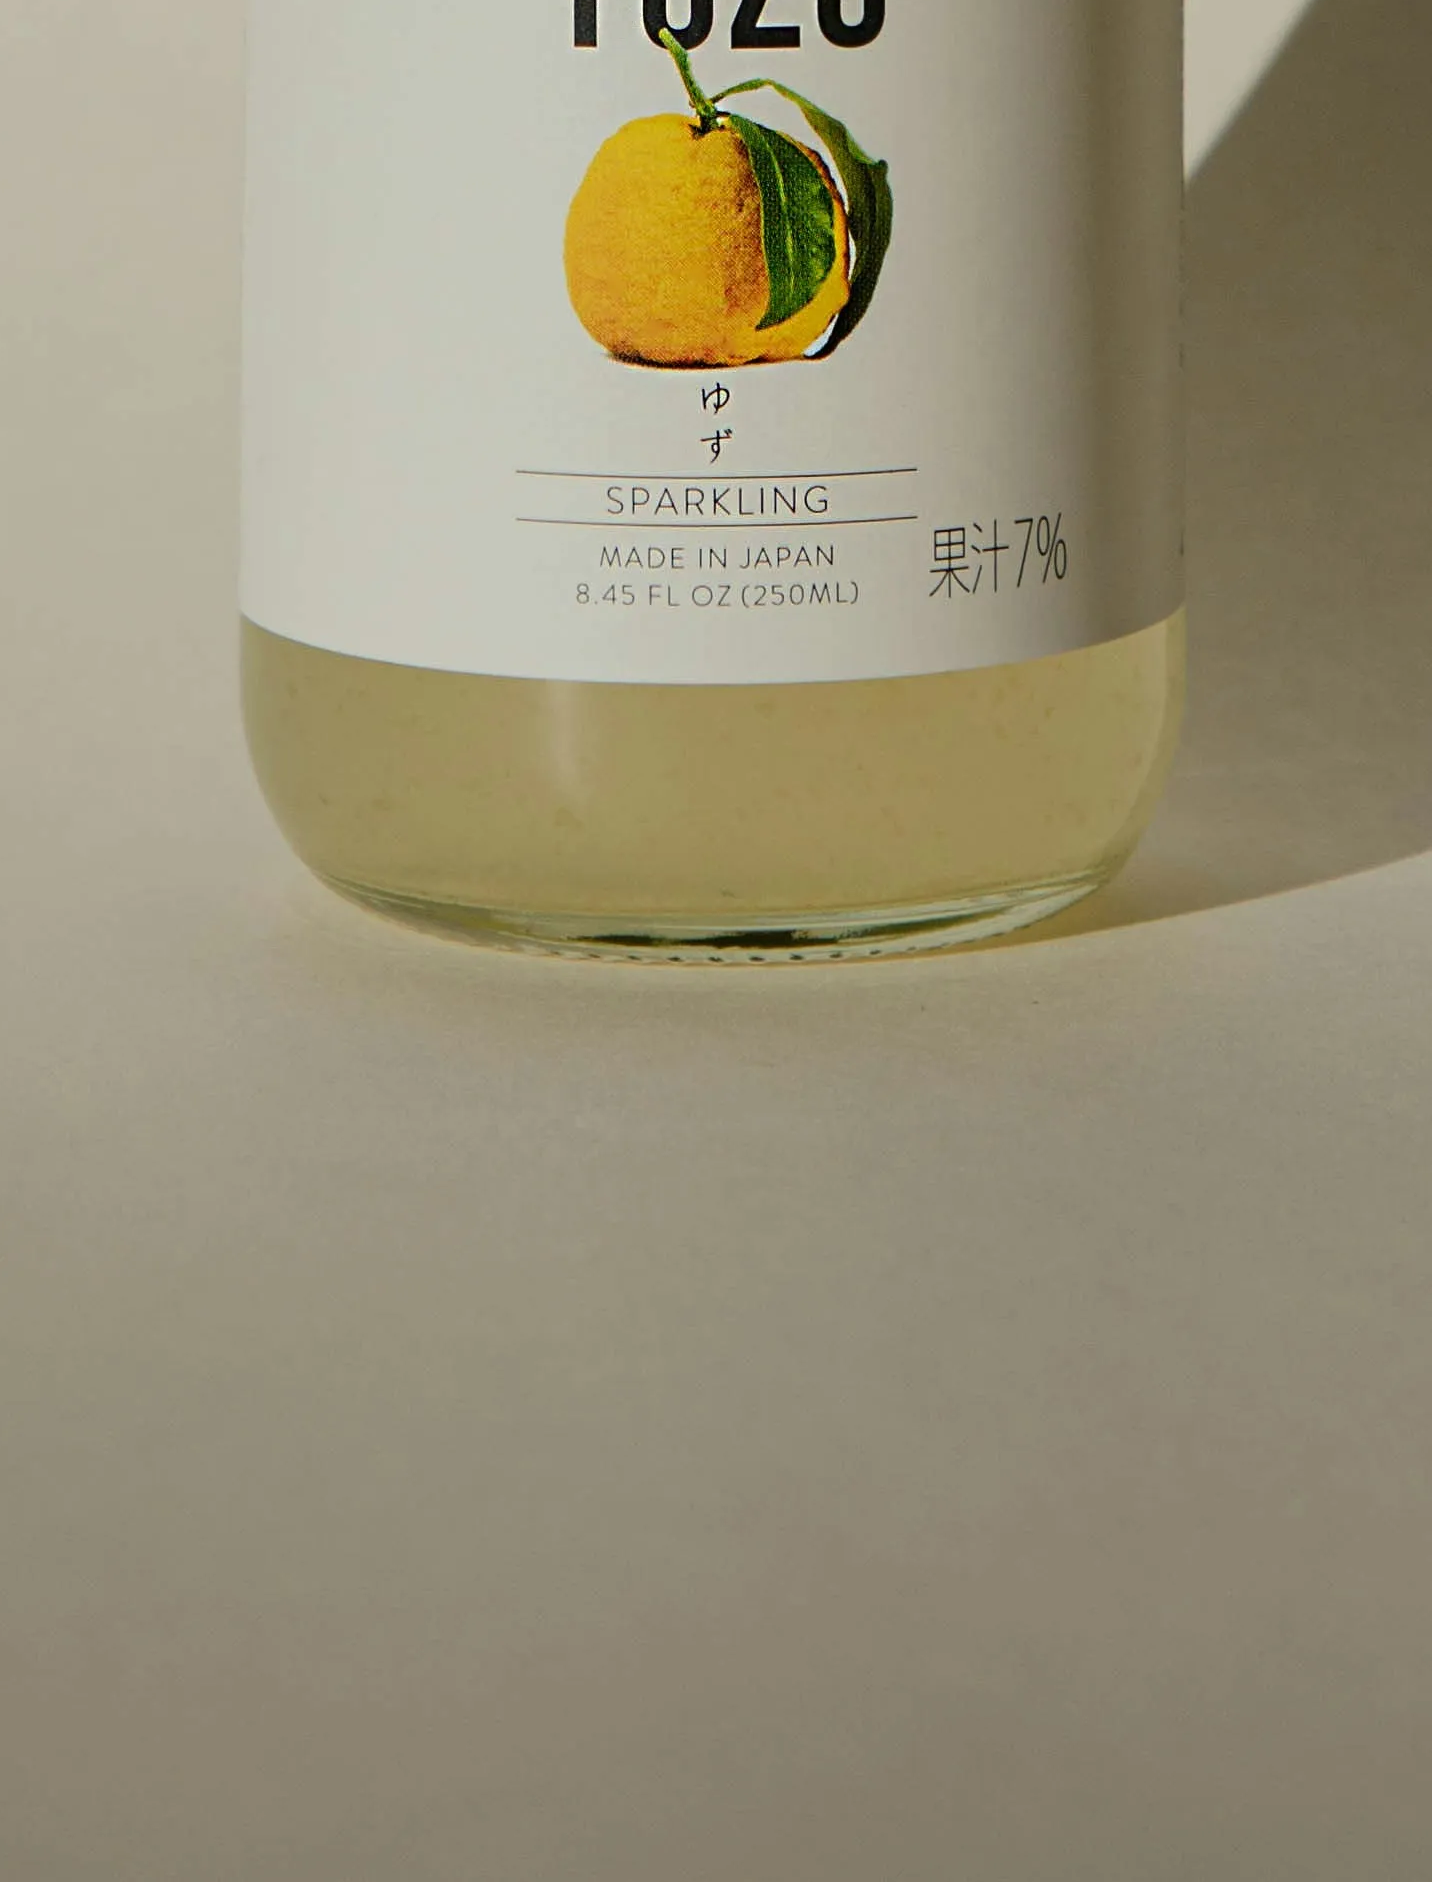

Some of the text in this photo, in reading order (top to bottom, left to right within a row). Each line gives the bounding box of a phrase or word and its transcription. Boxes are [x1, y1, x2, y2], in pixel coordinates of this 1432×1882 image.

[700, 382, 734, 464] ゆず
[606, 484, 830, 516] SPARKLING
[599, 544, 836, 570] MADE IN JAPAN
[575, 581, 860, 609] 8.45 FL OZ (250ML)
